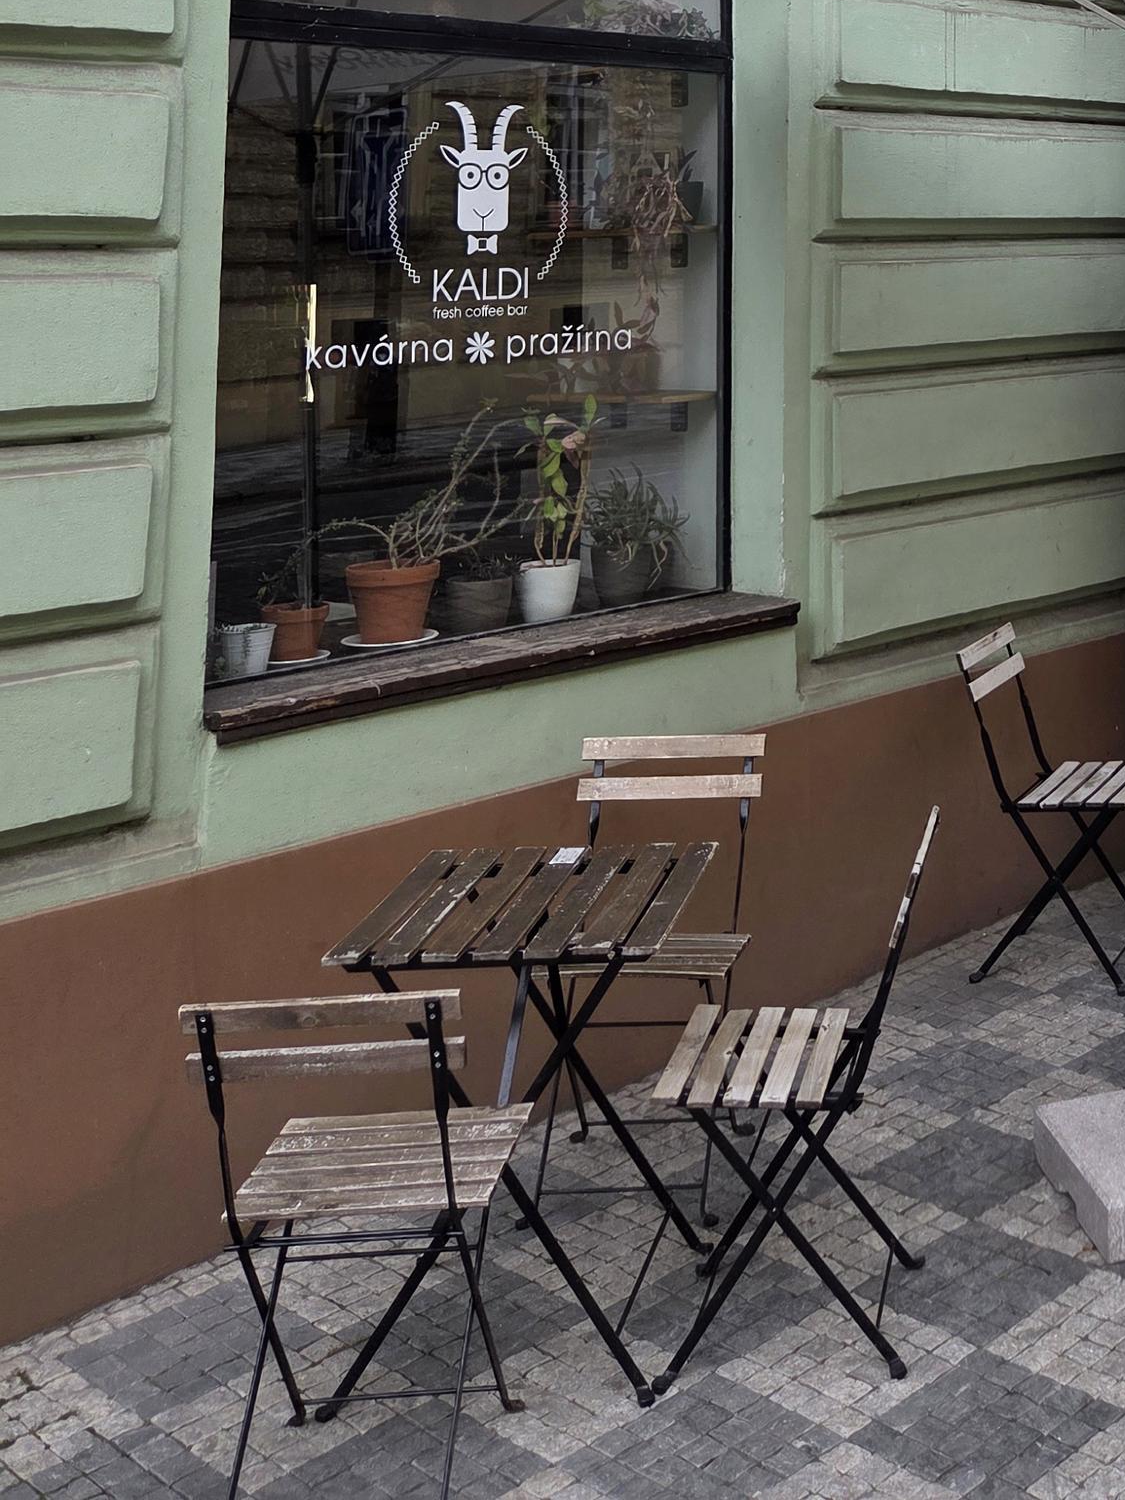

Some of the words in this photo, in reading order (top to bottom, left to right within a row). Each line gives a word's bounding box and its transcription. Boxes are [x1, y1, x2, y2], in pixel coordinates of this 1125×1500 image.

[432, 267, 529, 302] KALDI
[432, 306, 462, 319] fresh
[465, 304, 505, 318] coffee
[507, 304, 528, 316] bar
[305, 333, 453, 370] kavárna
[506, 324, 632, 364] pražírna
